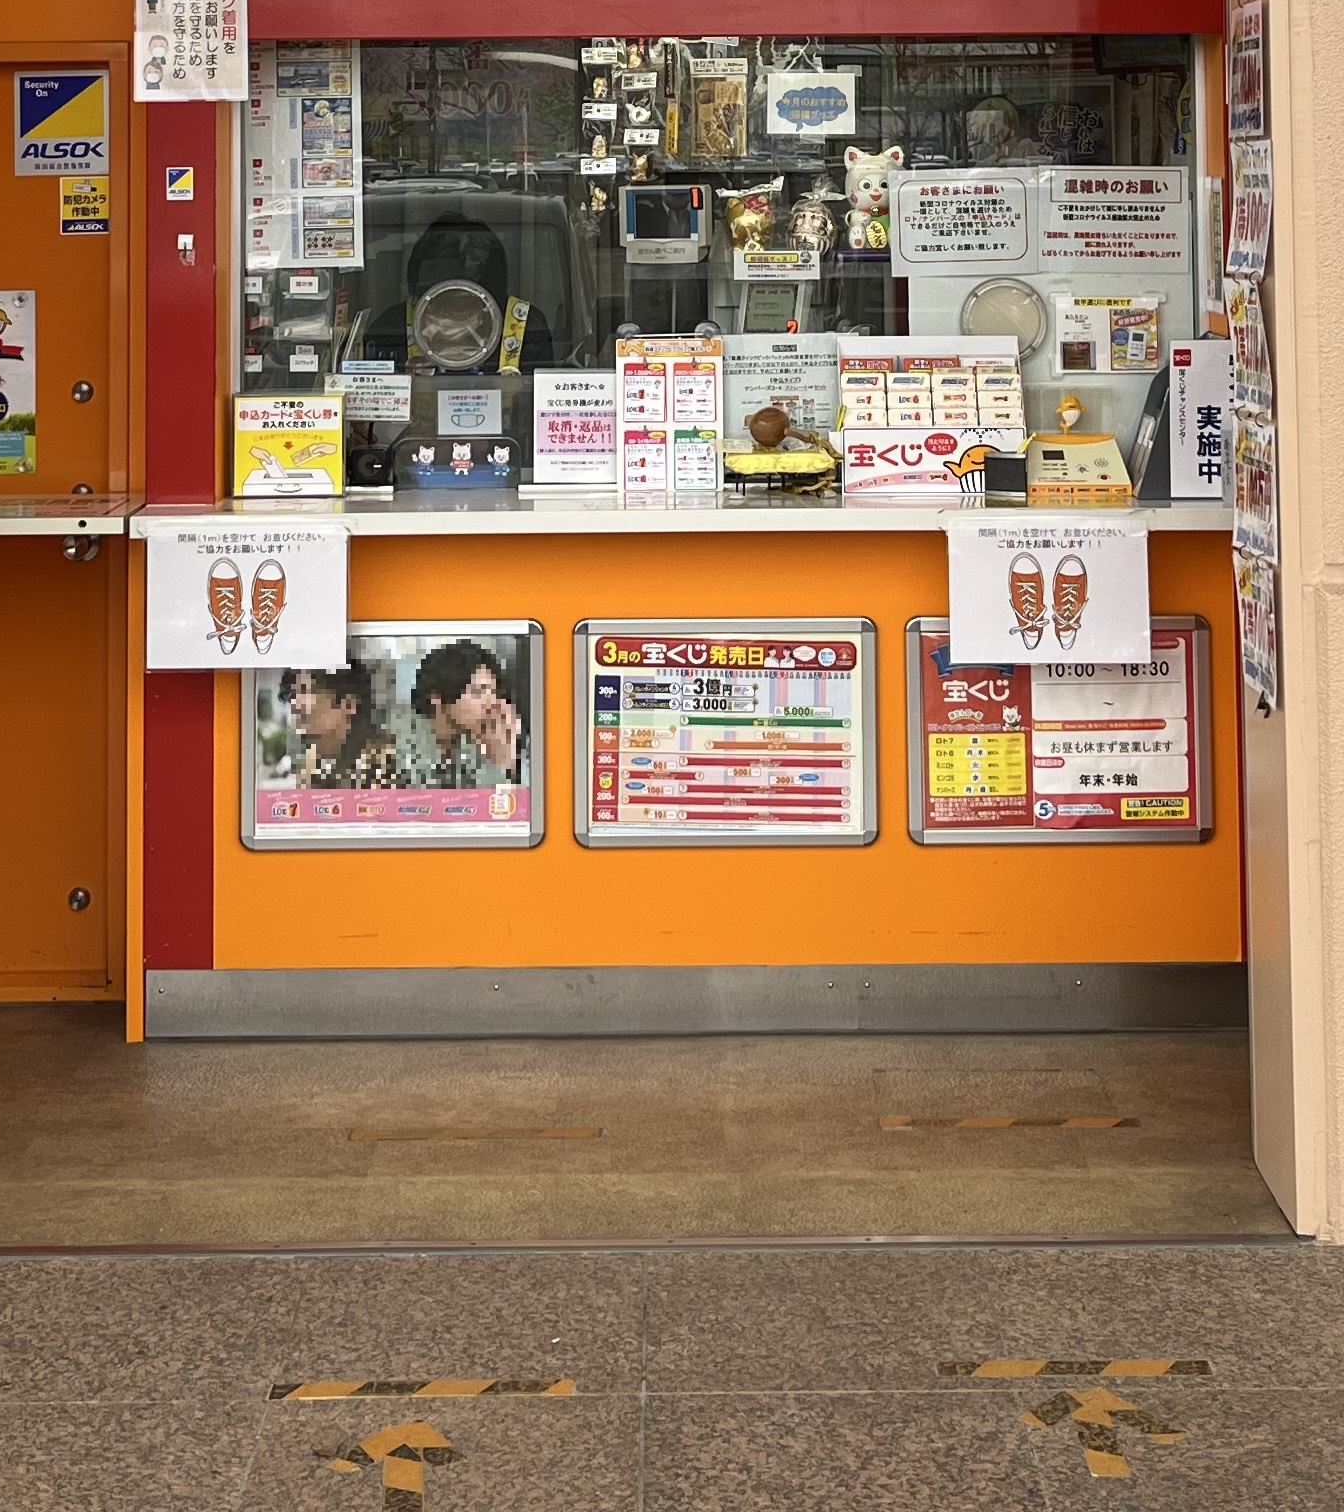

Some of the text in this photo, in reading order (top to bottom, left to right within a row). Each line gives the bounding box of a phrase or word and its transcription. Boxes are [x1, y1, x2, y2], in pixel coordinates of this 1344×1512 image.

[205, 2, 219, 80] お願いします
[24, 80, 60, 91] Security
[35, 89, 49, 97] On
[20, 141, 105, 159] ALSOK
[1064, 178, 1169, 195] 混雑時のお願い
[63, 194, 107, 206] 防犯カメラ
[75, 223, 105, 231] ALSOK
[1196, 404, 1222, 484] 実施中
[847, 443, 923, 468] 宝くじ
[602, 642, 765, 666] 3月の宝くじ発売日
[1046, 663, 1096, 678] 10:00
[1120, 661, 1170, 677] 18:30
[942, 679, 1010, 703] 宝くじ
[1050, 740, 1174, 754] お昼も休まず営業します
[1079, 773, 1139, 787] 年末・年始
